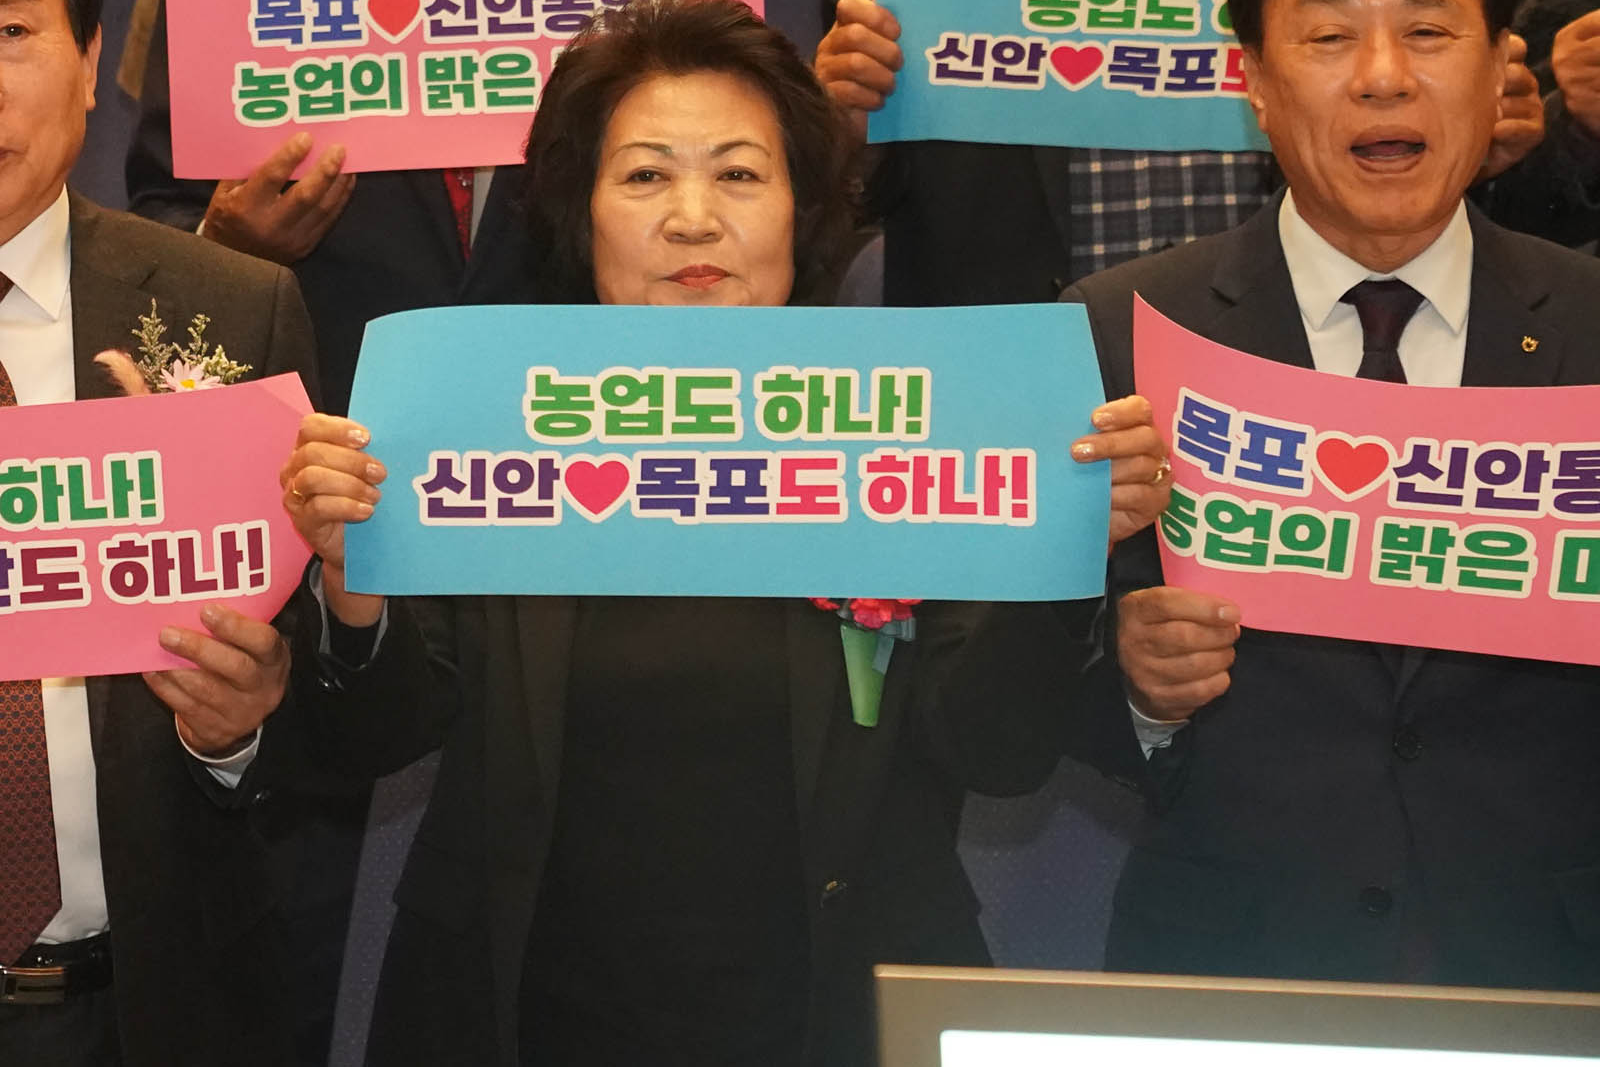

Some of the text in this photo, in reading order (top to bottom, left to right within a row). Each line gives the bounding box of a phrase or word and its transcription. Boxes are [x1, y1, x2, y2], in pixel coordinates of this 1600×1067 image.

[237, 53, 536, 120] 농업의 밝은
[932, 36, 1048, 84] 신안
[530, 373, 924, 437] 농업도 하나!
[1177, 395, 1309, 491] 목포
[420, 454, 1030, 519] 신안 목포도 하나!
[104, 527, 266, 598] 하나!
[1378, 522, 1531, 593] 밝은
